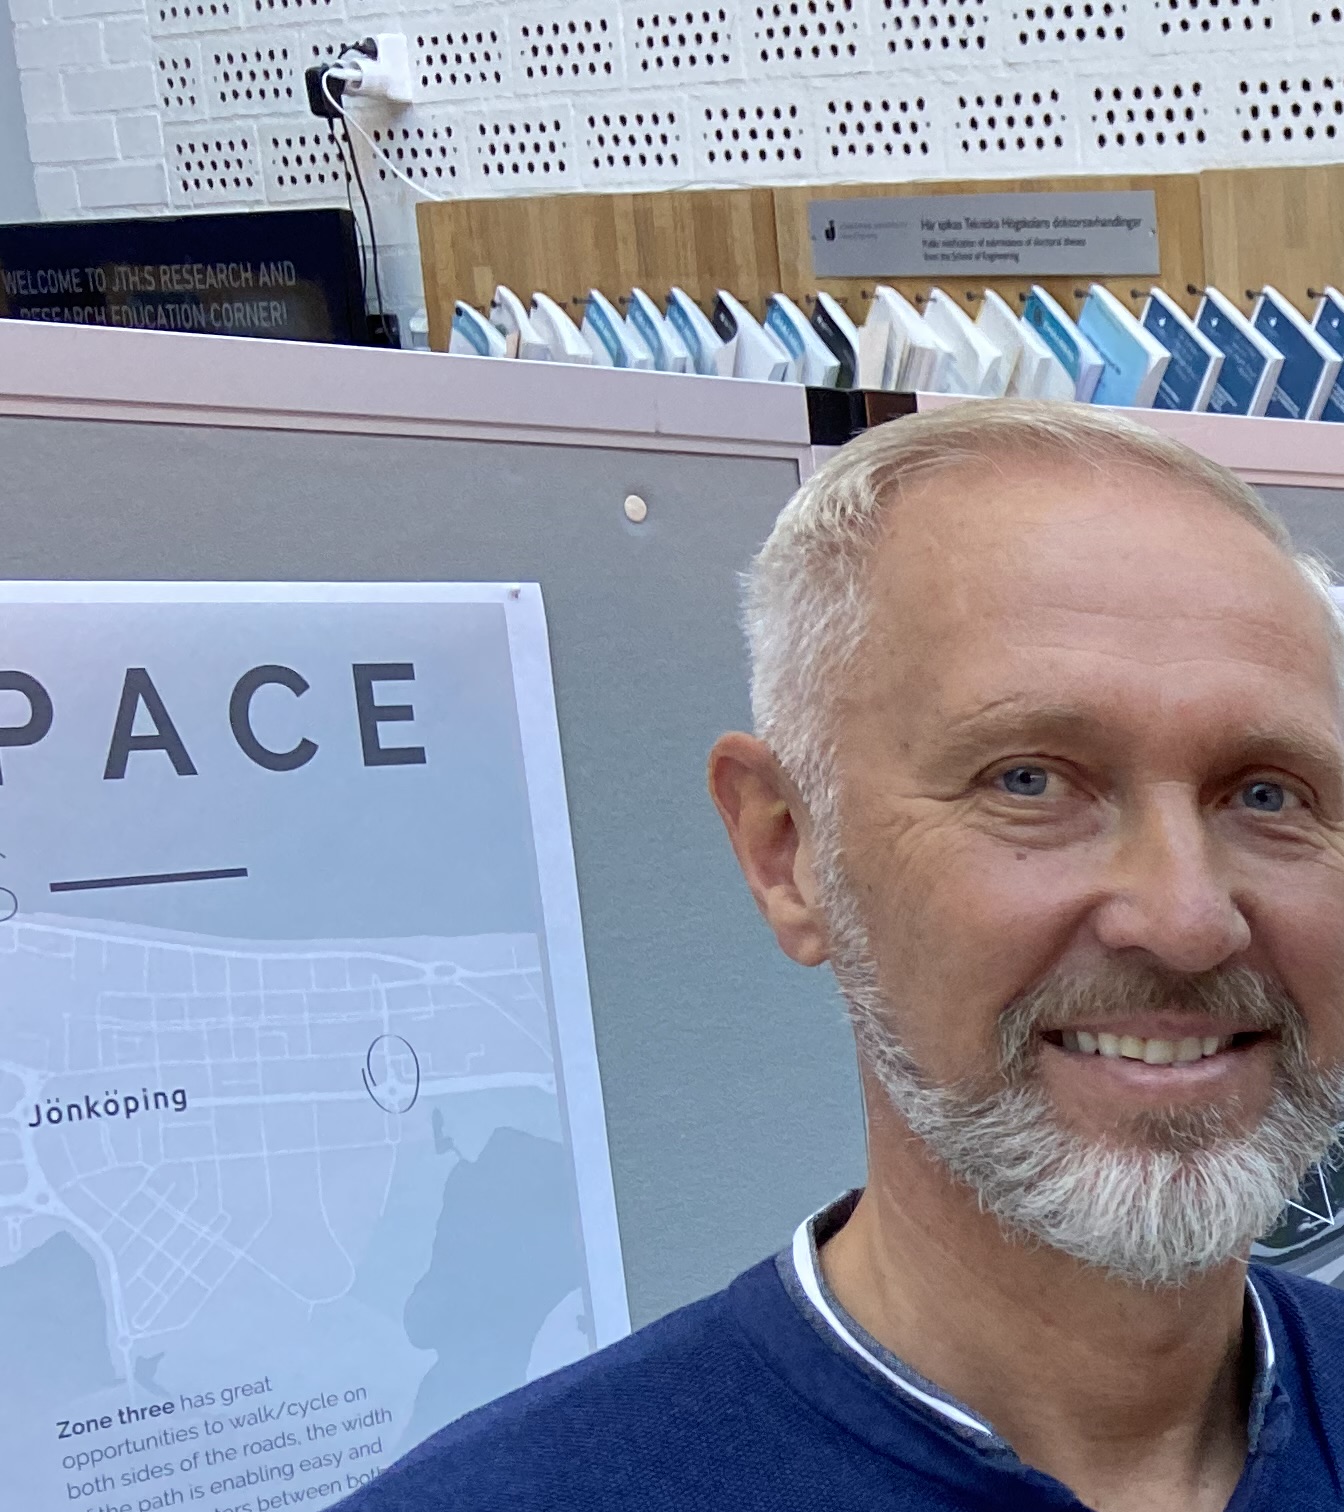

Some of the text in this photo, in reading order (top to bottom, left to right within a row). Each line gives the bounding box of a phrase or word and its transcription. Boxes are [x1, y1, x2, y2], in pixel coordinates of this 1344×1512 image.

[2, 267, 83, 296] WELCOME
[85, 266, 106, 293] TO
[160, 262, 251, 291] RESEARCH
[259, 260, 297, 288] AND
[111, 302, 207, 329] EDUCATION
[210, 300, 288, 328] CORNER!
[0, 662, 427, 786] PACE
[28, 1086, 189, 1128] Jönköping
[56, 1375, 274, 1440] Zone three has great
[62, 1386, 368, 1471] opportunities to walk/cycle on
[66, 1474, 116, 1501] both
[120, 1461, 175, 1488] sides
[179, 1451, 202, 1472] of
[205, 1446, 238, 1467] the
[306, 1422, 338, 1442] the
[341, 1407, 393, 1433] width
[188, 1483, 206, 1501] is
[209, 1463, 295, 1496] enabling
[299, 1450, 344, 1473] easy
[347, 1435, 384, 1461] and
[257, 1479, 343, 1512] between
